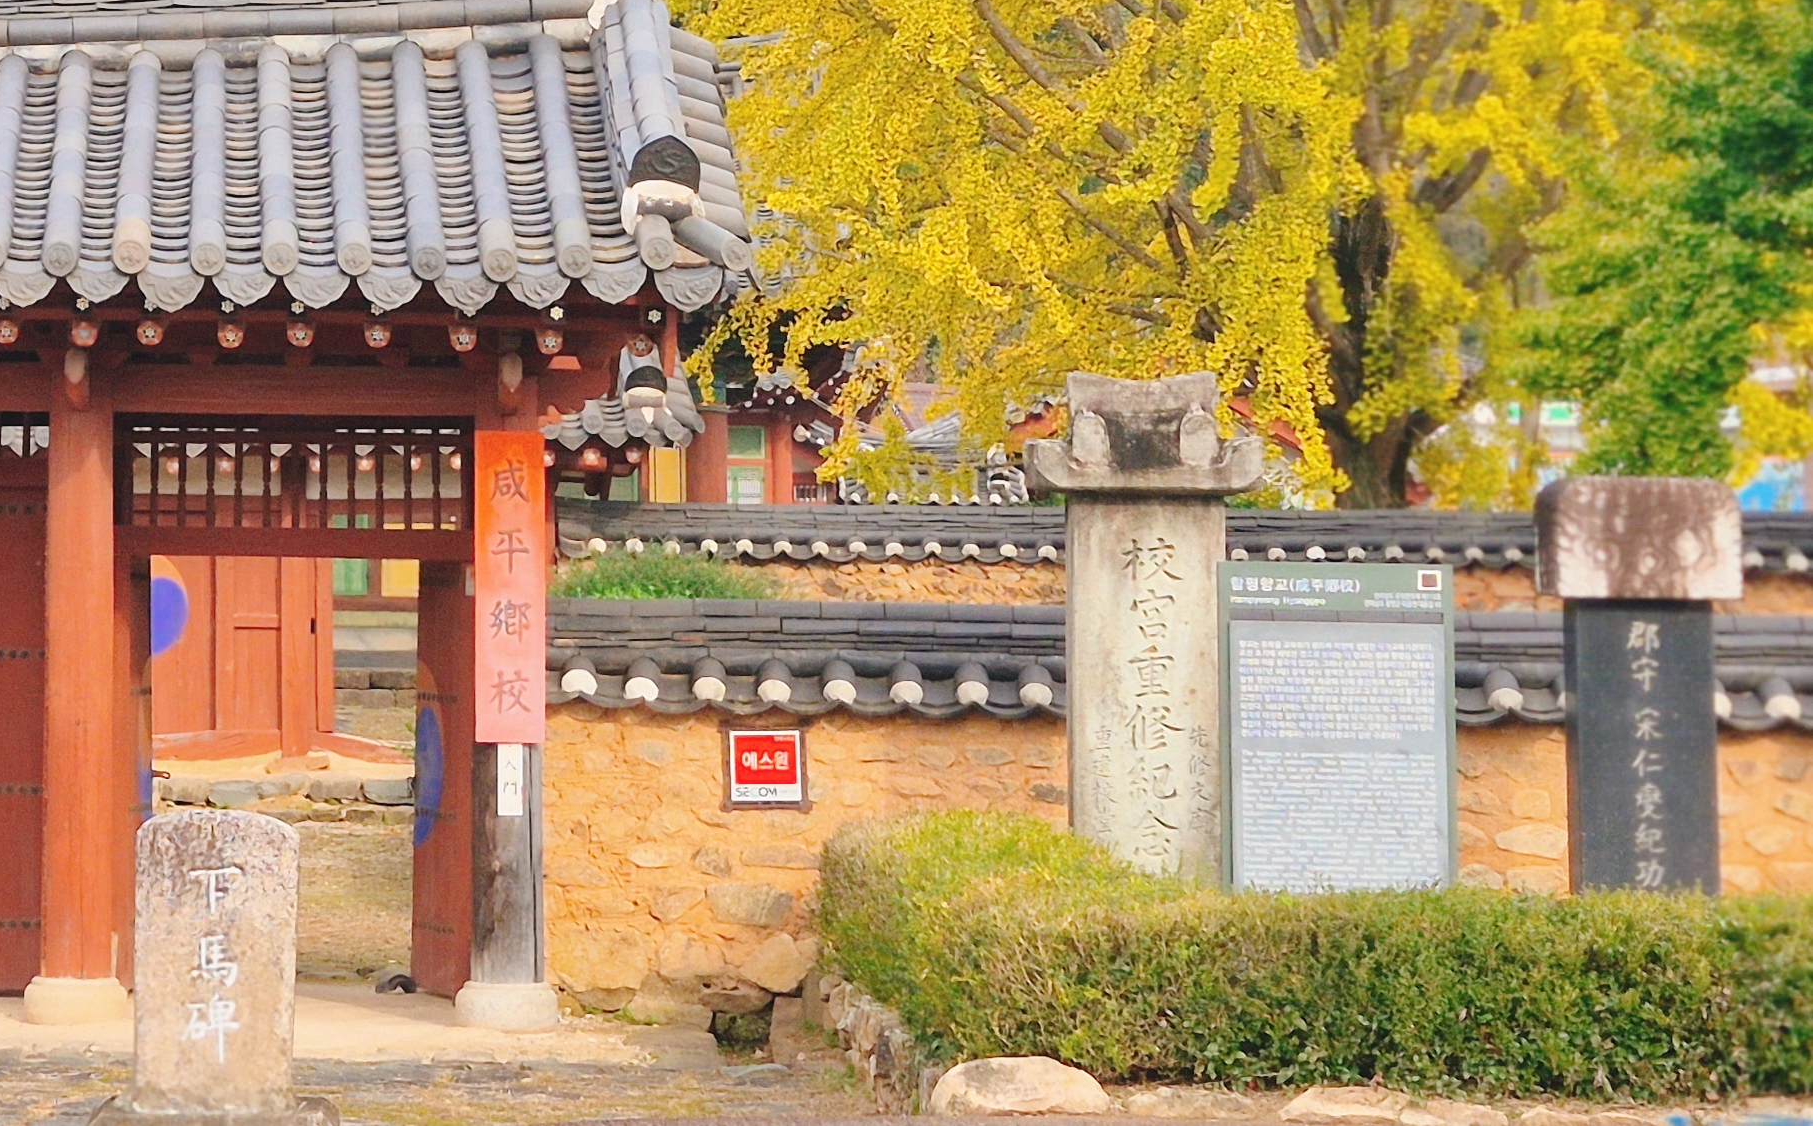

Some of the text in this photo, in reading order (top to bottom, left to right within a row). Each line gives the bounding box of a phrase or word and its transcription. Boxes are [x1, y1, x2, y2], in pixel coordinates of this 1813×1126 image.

[741, 750, 789, 771] 에스원
[179, 865, 243, 1065] 下馬碑
